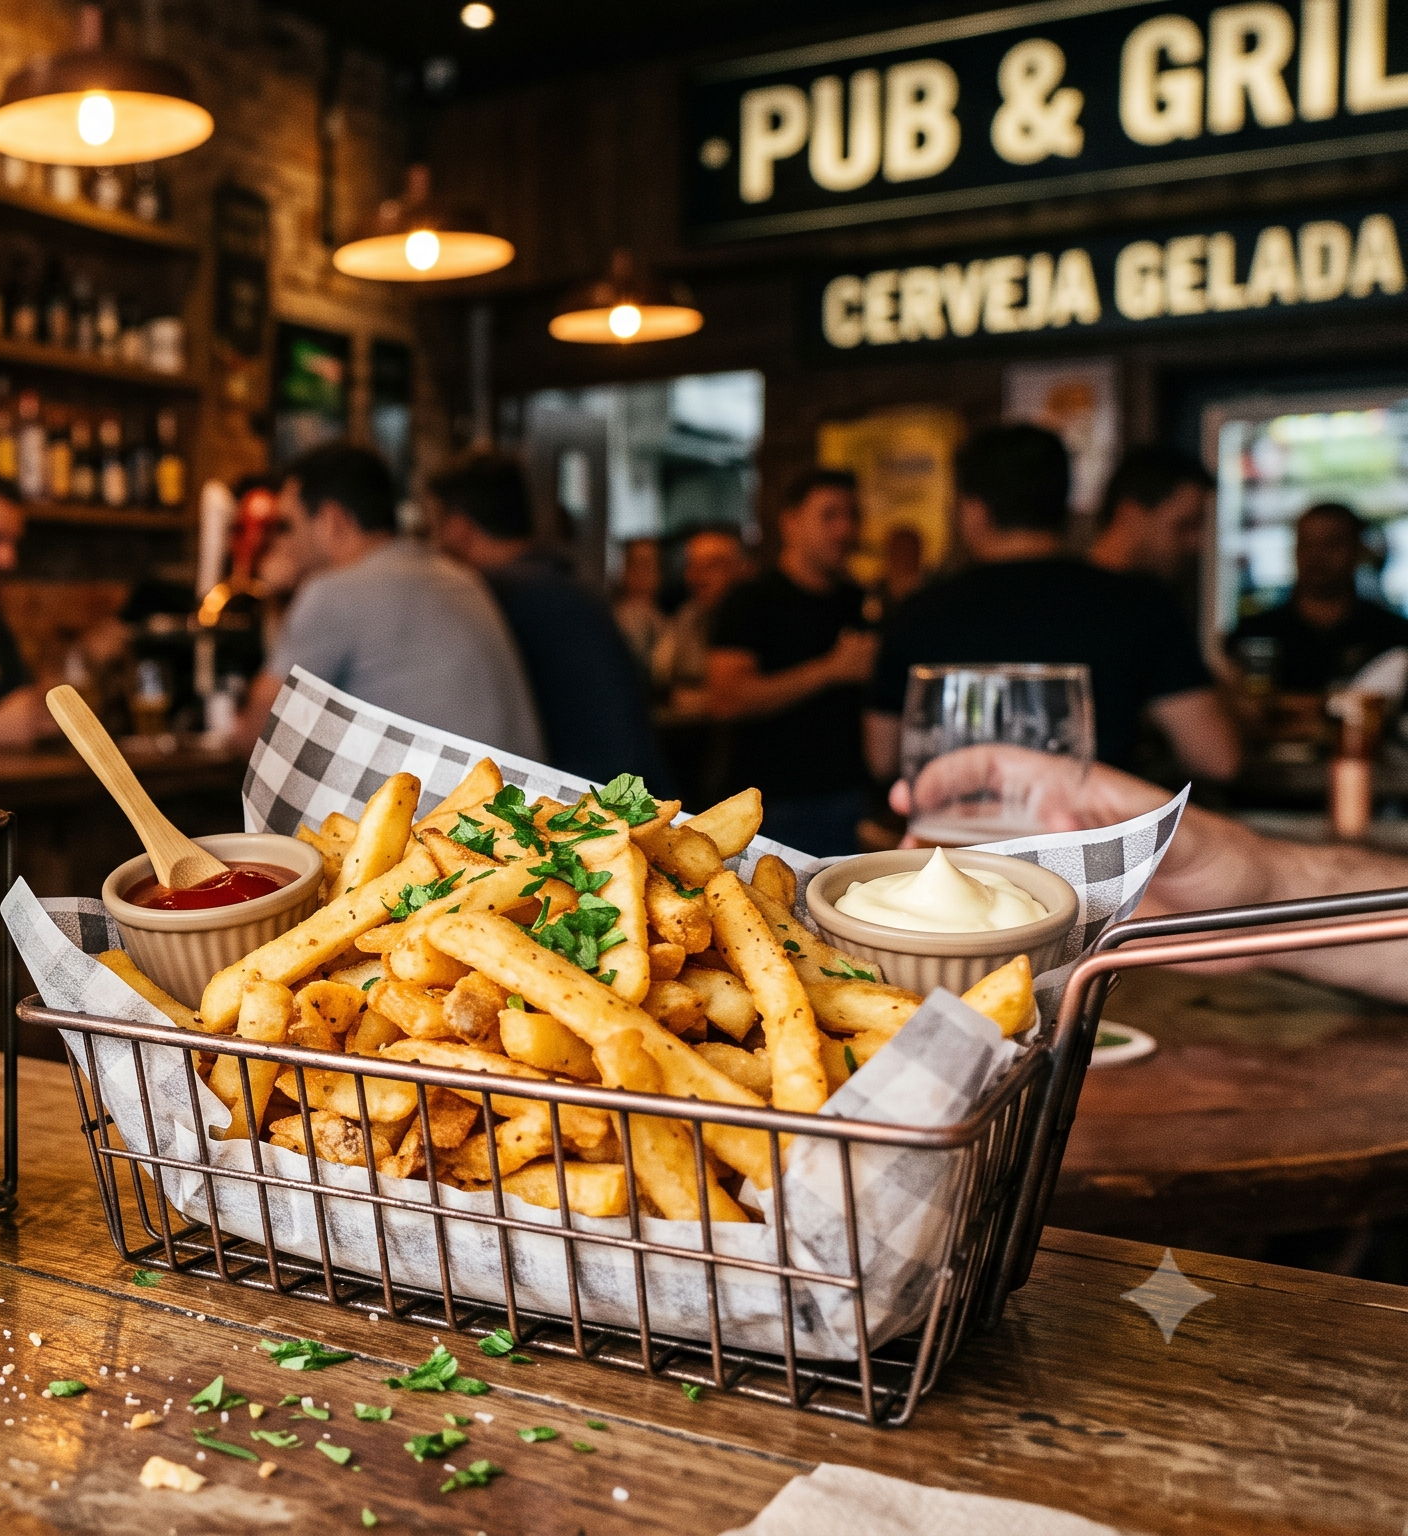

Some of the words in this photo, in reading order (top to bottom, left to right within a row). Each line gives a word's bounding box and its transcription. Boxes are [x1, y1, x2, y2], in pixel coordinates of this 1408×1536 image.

[739, 58, 961, 203] PUB
[993, 37, 1085, 165] &
[1120, 0, 1408, 147] GRIL
[822, 248, 1101, 349] CERVEJA
[1114, 213, 1406, 321] GELADA
